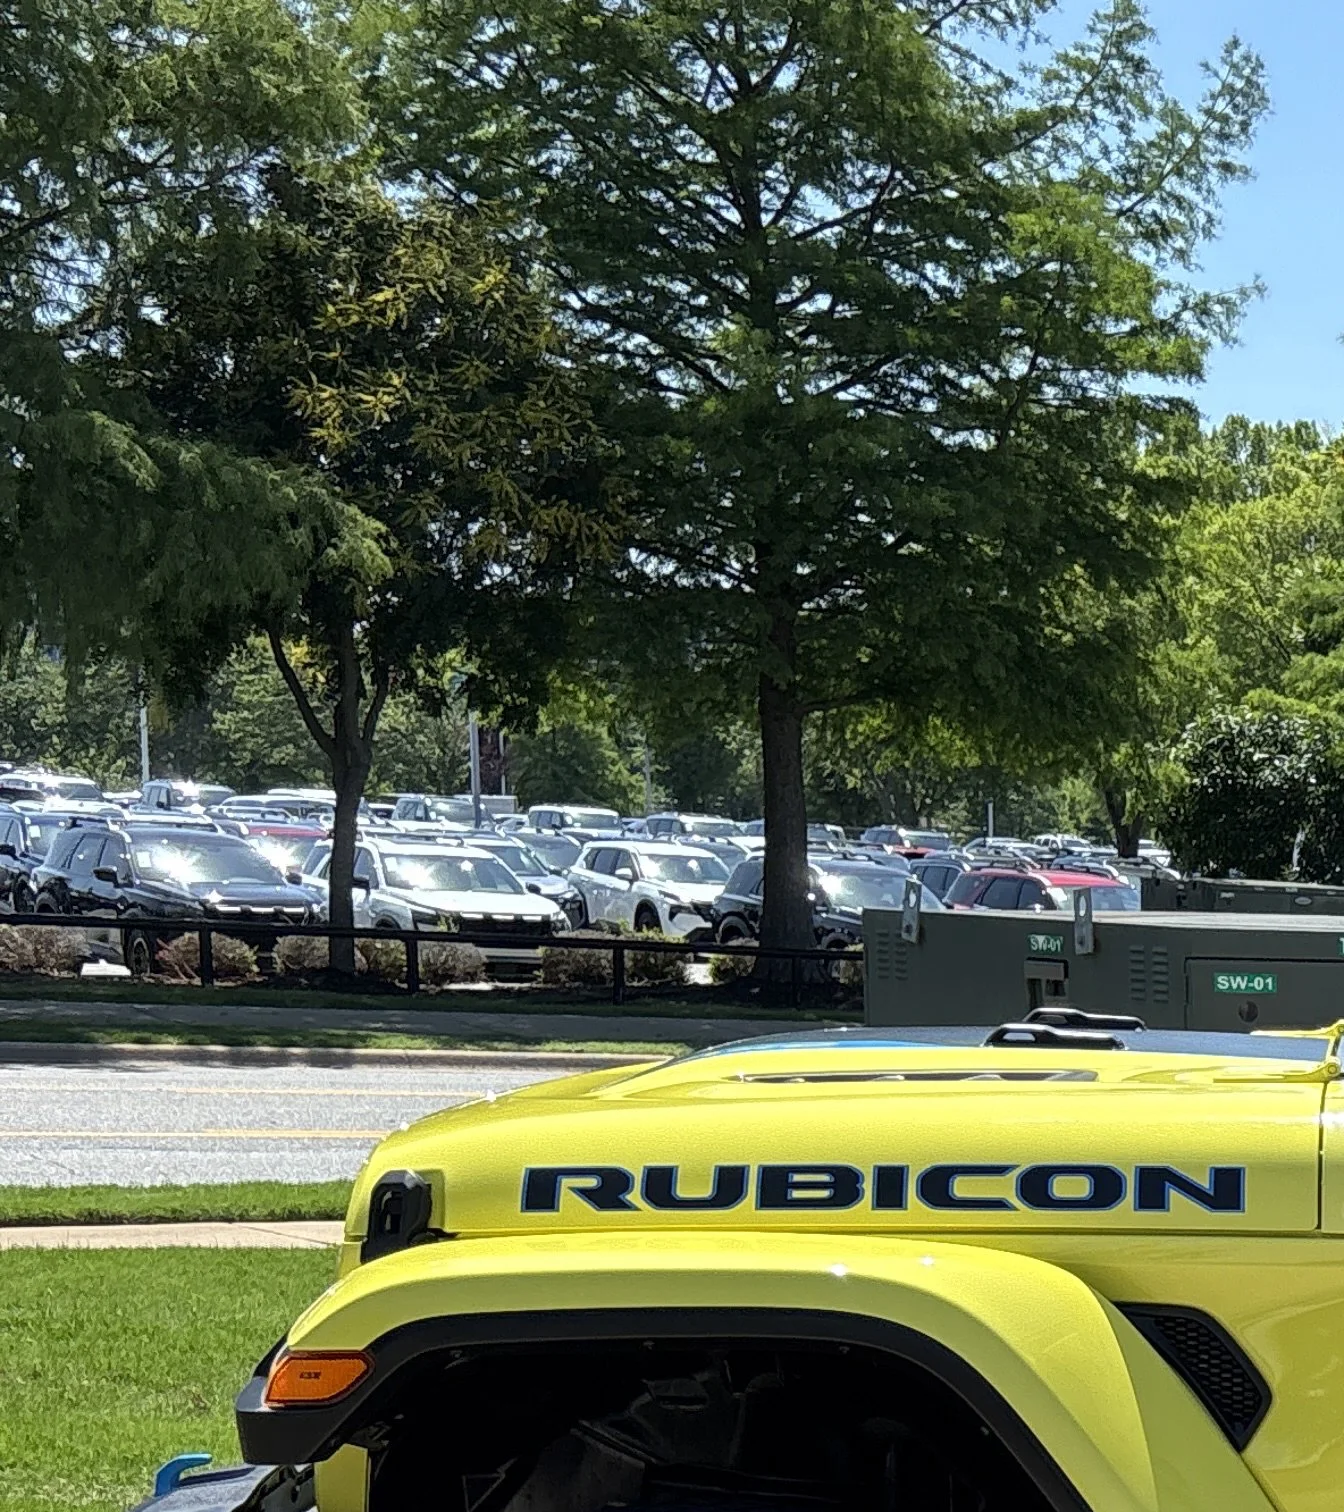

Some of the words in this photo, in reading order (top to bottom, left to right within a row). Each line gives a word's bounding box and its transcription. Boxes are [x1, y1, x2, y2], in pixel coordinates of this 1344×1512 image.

[1030, 935, 1062, 952] SW-01
[1216, 976, 1274, 991] SW-01
[520, 1165, 1247, 1212] RUBICON
